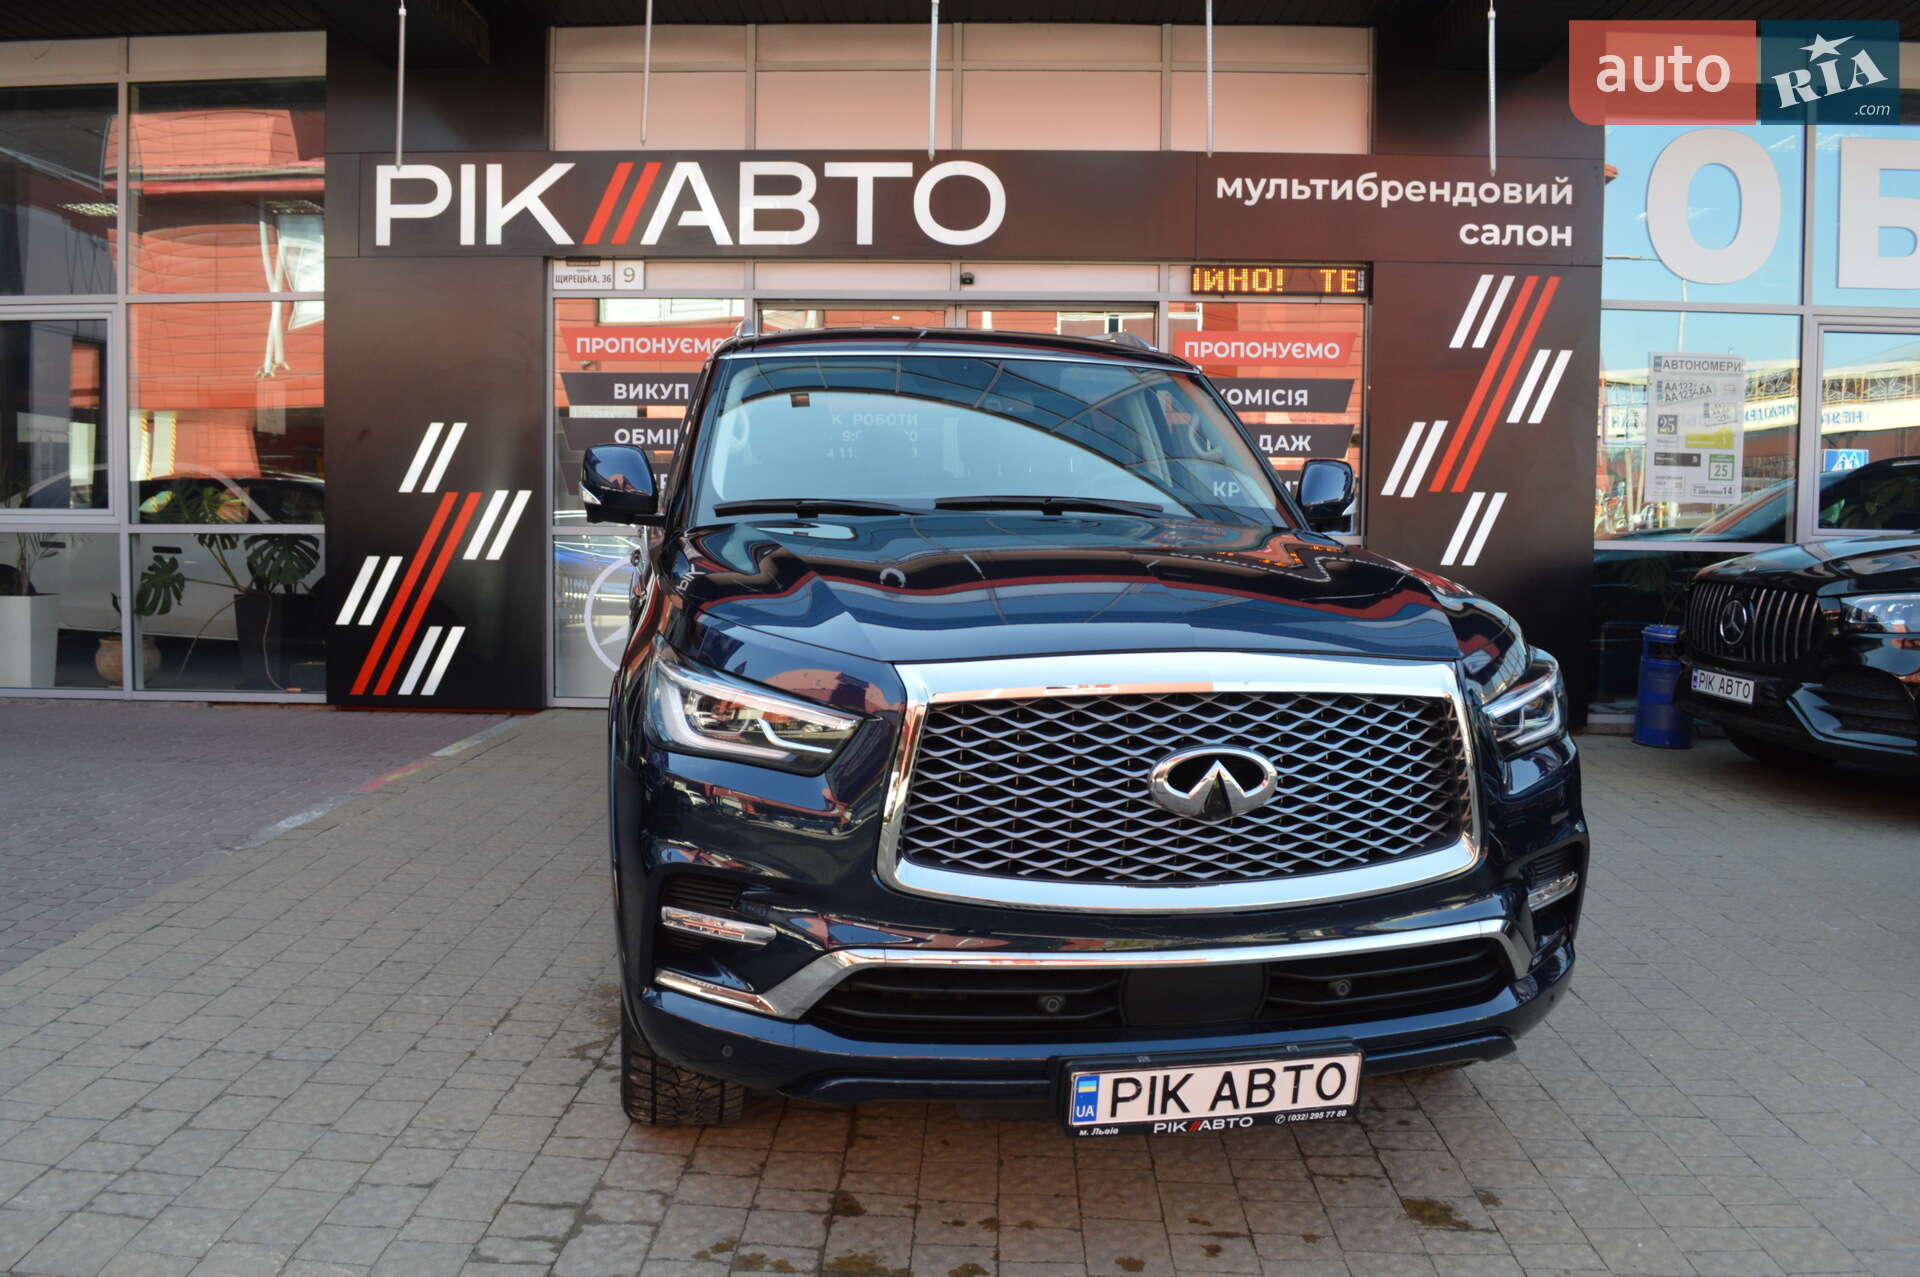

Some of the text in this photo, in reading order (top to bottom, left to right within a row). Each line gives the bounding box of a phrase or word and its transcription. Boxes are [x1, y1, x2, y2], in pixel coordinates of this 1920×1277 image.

[1216, 172, 1574, 208] мультибрендовий
[640, 160, 1007, 246] АВТО
[1459, 222, 1573, 247] салон
[623, 267, 636, 283] 9
[1184, 341, 1341, 359] ПРОПОНУЄМО
[1663, 359, 1742, 372] АВТОНОМЕРИ
[613, 383, 689, 400] ВИКУП
[1220, 388, 1309, 406] ОМІСІЯ
[1258, 435, 1312, 453] ДАЖ
[1713, 464, 1728, 477] 25
[1719, 677, 1751, 698] АВТО
[1208, 1061, 1347, 1112] АВТО
[1075, 1104, 1095, 1118] UA
